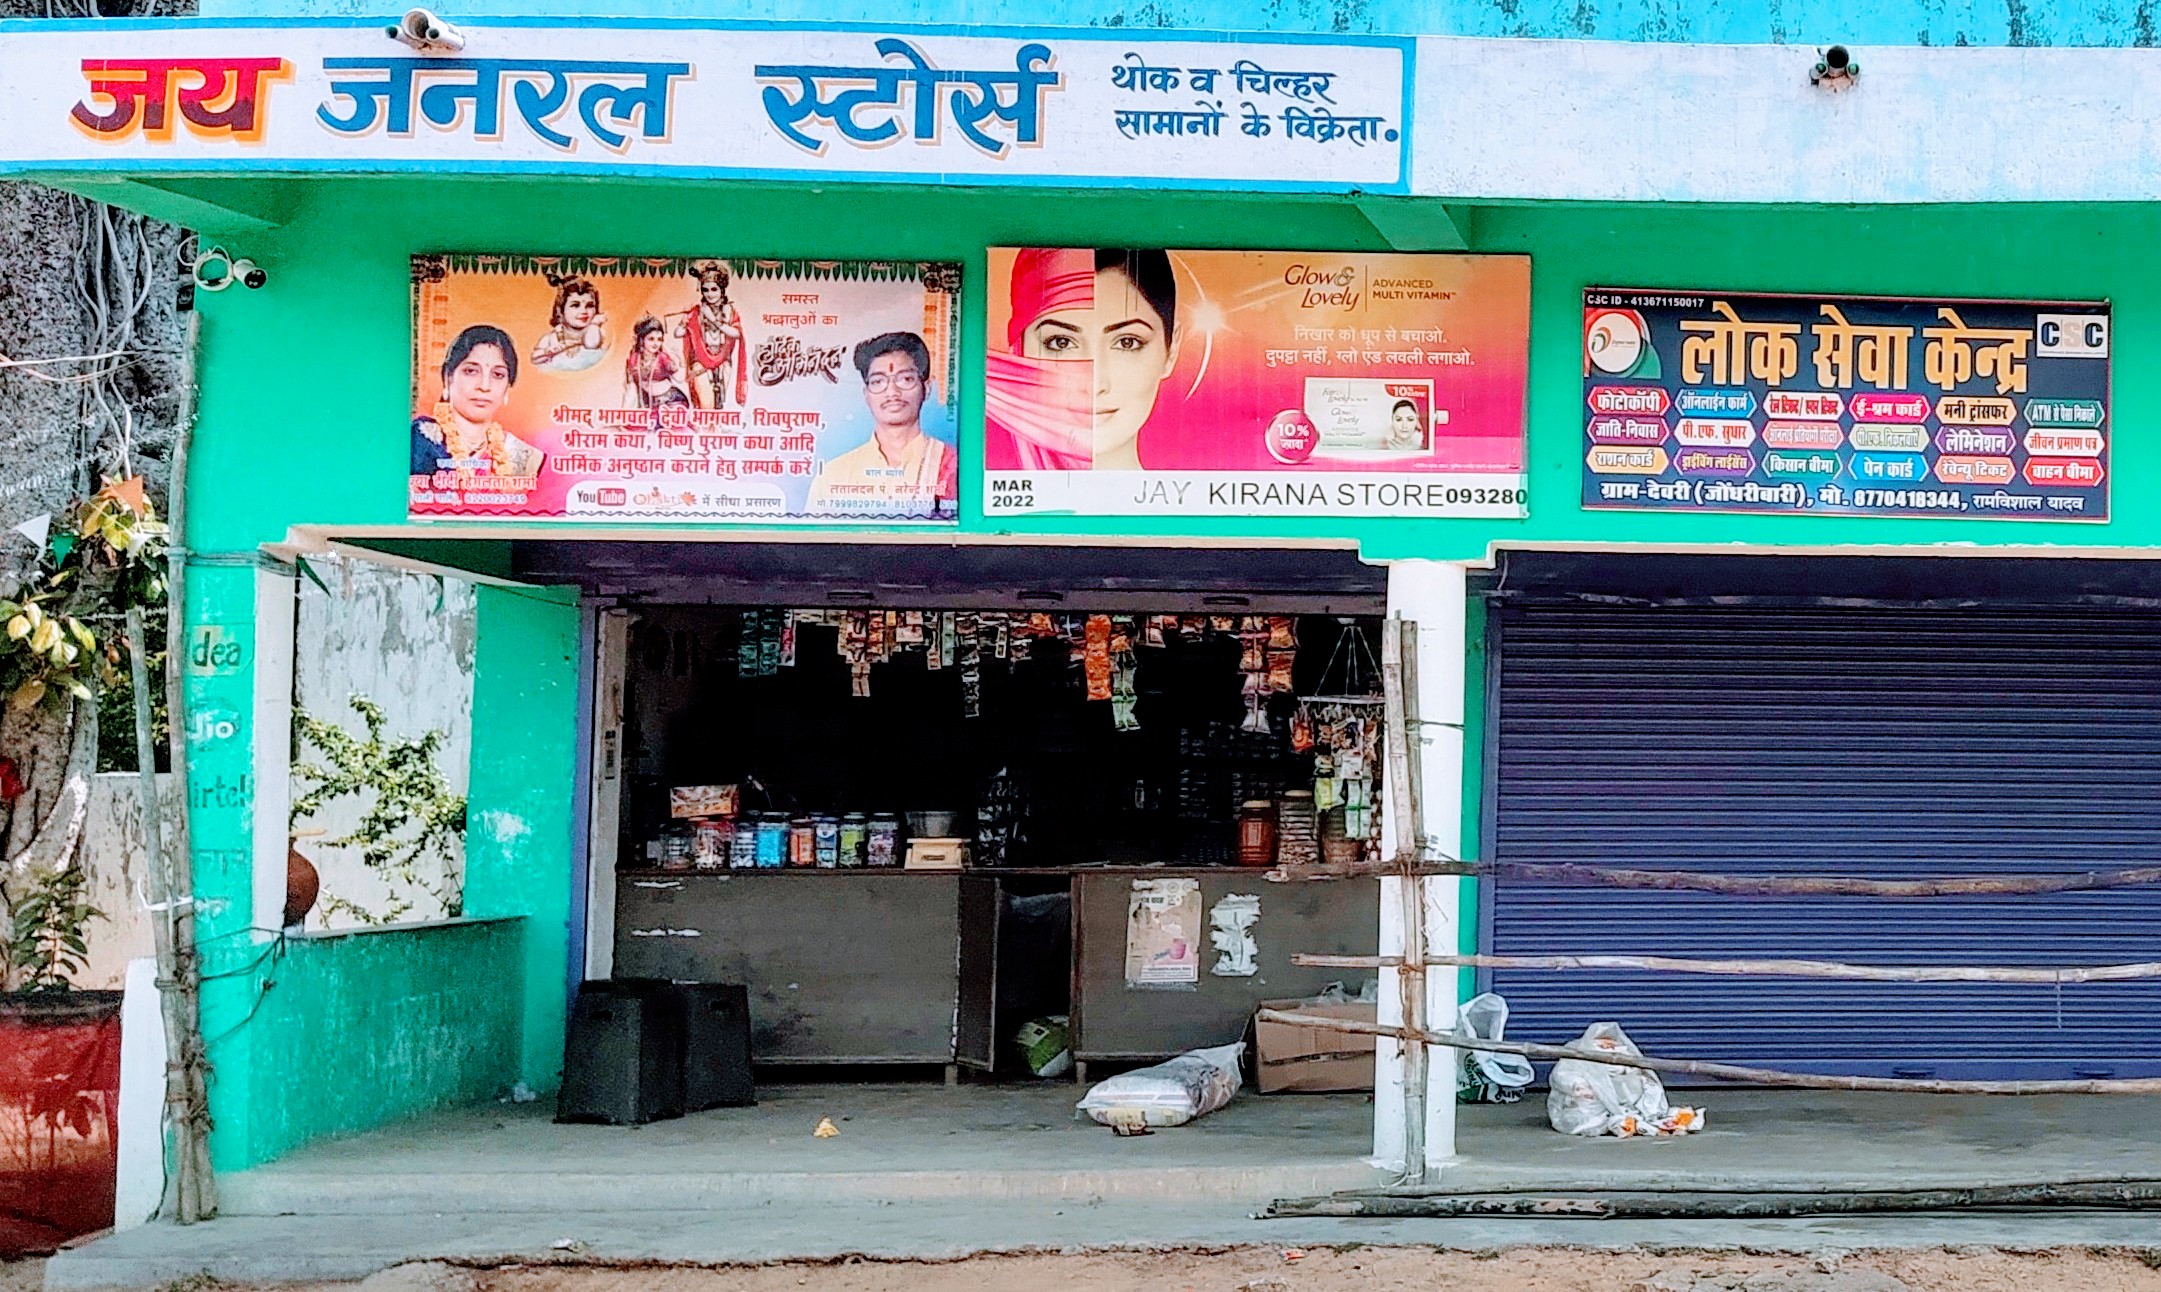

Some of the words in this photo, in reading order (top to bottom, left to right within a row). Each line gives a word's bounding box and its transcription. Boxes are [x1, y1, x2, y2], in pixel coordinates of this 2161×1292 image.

[1110, 53, 1181, 95] थोक
[1187, 67, 1221, 96] व
[1228, 59, 1337, 104] चिल्हर
[70, 57, 292, 146] जय
[315, 57, 694, 152] जनरल
[755, 38, 1064, 158] स्टोर्स
[1114, 102, 1223, 139] सामानों
[1241, 103, 1271, 139] के
[1372, 279, 1434, 289] ADVANCED
[782, 293, 819, 304] समस्त
[1300, 287, 1360, 312] Lovely
[1372, 291, 1404, 300] MULTI
[1610, 296, 1622, 305] ID
[762, 311, 816, 329] श्रद्धालुओं
[822, 315, 839, 325] का
[1294, 325, 1334, 342] निखार
[1338, 326, 1356, 343] को
[1361, 329, 1381, 348] धूप
[1385, 326, 1397, 343] से
[2041, 321, 2104, 348] CSC
[1265, 348, 1298, 368] दुपट्टा
[1336, 347, 1358, 365] ग्लो
[1386, 347, 1423, 365] लवली
[1679, 300, 1801, 387] लोक
[1811, 303, 1913, 389] सेवा
[1922, 306, 2033, 396] केन्द्र
[1596, 391, 1661, 412] फोटोकॉपी
[1856, 397, 1893, 417] ई-श्रम
[1895, 400, 1923, 418] कार्ड
[1944, 400, 1966, 419] मनी
[1969, 400, 2008, 422] ट्रांसफर
[553, 407, 594, 430] श्रीमद्
[659, 407, 688, 428] देवी
[2031, 404, 2052, 422] ATM
[1278, 423, 1310, 437] 10%
[1595, 419, 1659, 440] जाति-निवास
[1722, 425, 1747, 444] सुधार
[564, 432, 607, 450] श्रीराम
[658, 432, 696, 456] विष्णु
[699, 434, 738, 457] पुराण
[744, 436, 775, 451] कथा
[780, 432, 816, 454] आदि
[1945, 429, 2008, 453] लेमिनेशन
[2028, 432, 2054, 450] जीवन
[2057, 436, 2083, 451] प्रमाण
[2085, 436, 2098, 451] पत्र
[553, 454, 603, 474] धार्मिक
[608, 457, 665, 480] अनुष्ठान
[671, 455, 711, 475] कराने
[715, 456, 737, 480] हेतु
[741, 455, 785, 475] सम्पर्क
[1596, 451, 1627, 467] राशन
[1628, 449, 1655, 467] कार्ड
[1769, 454, 1807, 474] किसान
[1863, 456, 1884, 478] पेन
[1887, 457, 1914, 478] कार्ड
[1975, 460, 2008, 477] टिकट
[2032, 464, 2064, 480] वाहन
[992, 480, 1034, 492] MAR
[1134, 480, 1192, 505] JAY
[1209, 482, 1326, 506] KIRANA
[1337, 482, 1444, 507] STORE
[715, 495, 742, 508] सीधा
[745, 497, 782, 509] प्रसारण
[992, 496, 1034, 508] 2022
[1972, 489, 2043, 511] रामविशाल
[2047, 496, 2085, 512] यादव
[187, 631, 242, 668] dea
[188, 773, 246, 809] irtel
